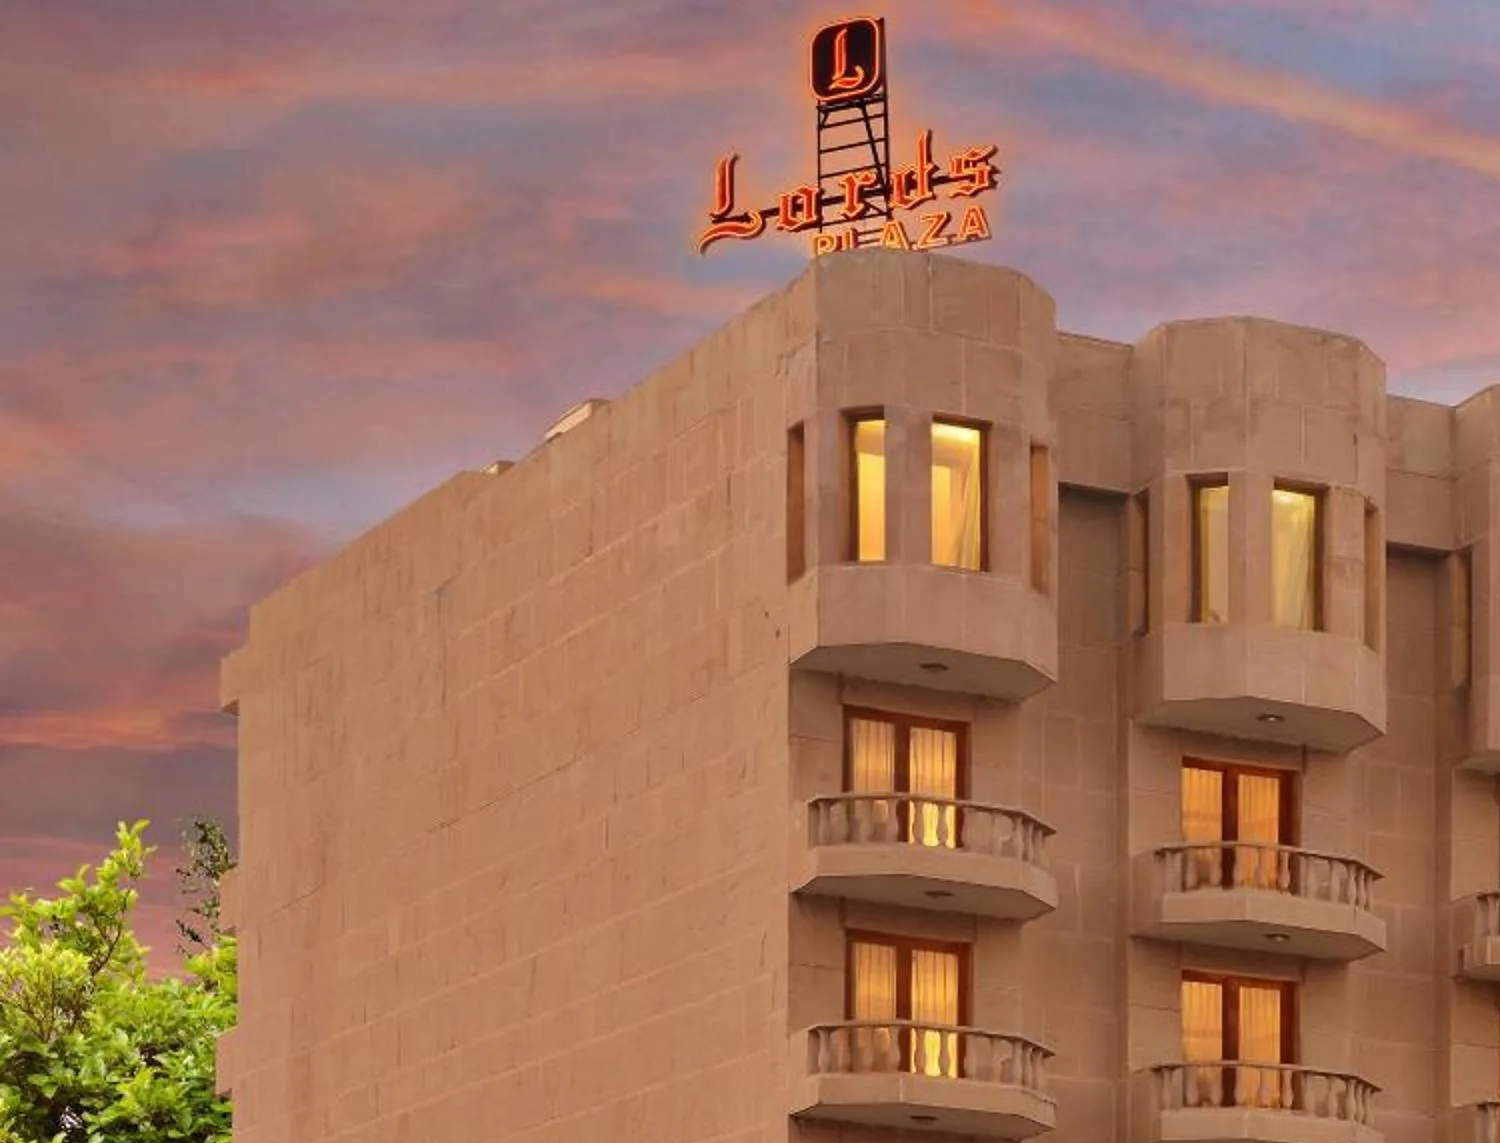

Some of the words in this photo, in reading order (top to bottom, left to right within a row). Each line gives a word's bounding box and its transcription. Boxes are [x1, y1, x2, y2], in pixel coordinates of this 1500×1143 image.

[828, 28, 865, 90] L
[700, 129, 998, 255] Lords
[812, 204, 990, 257] PLAZA
